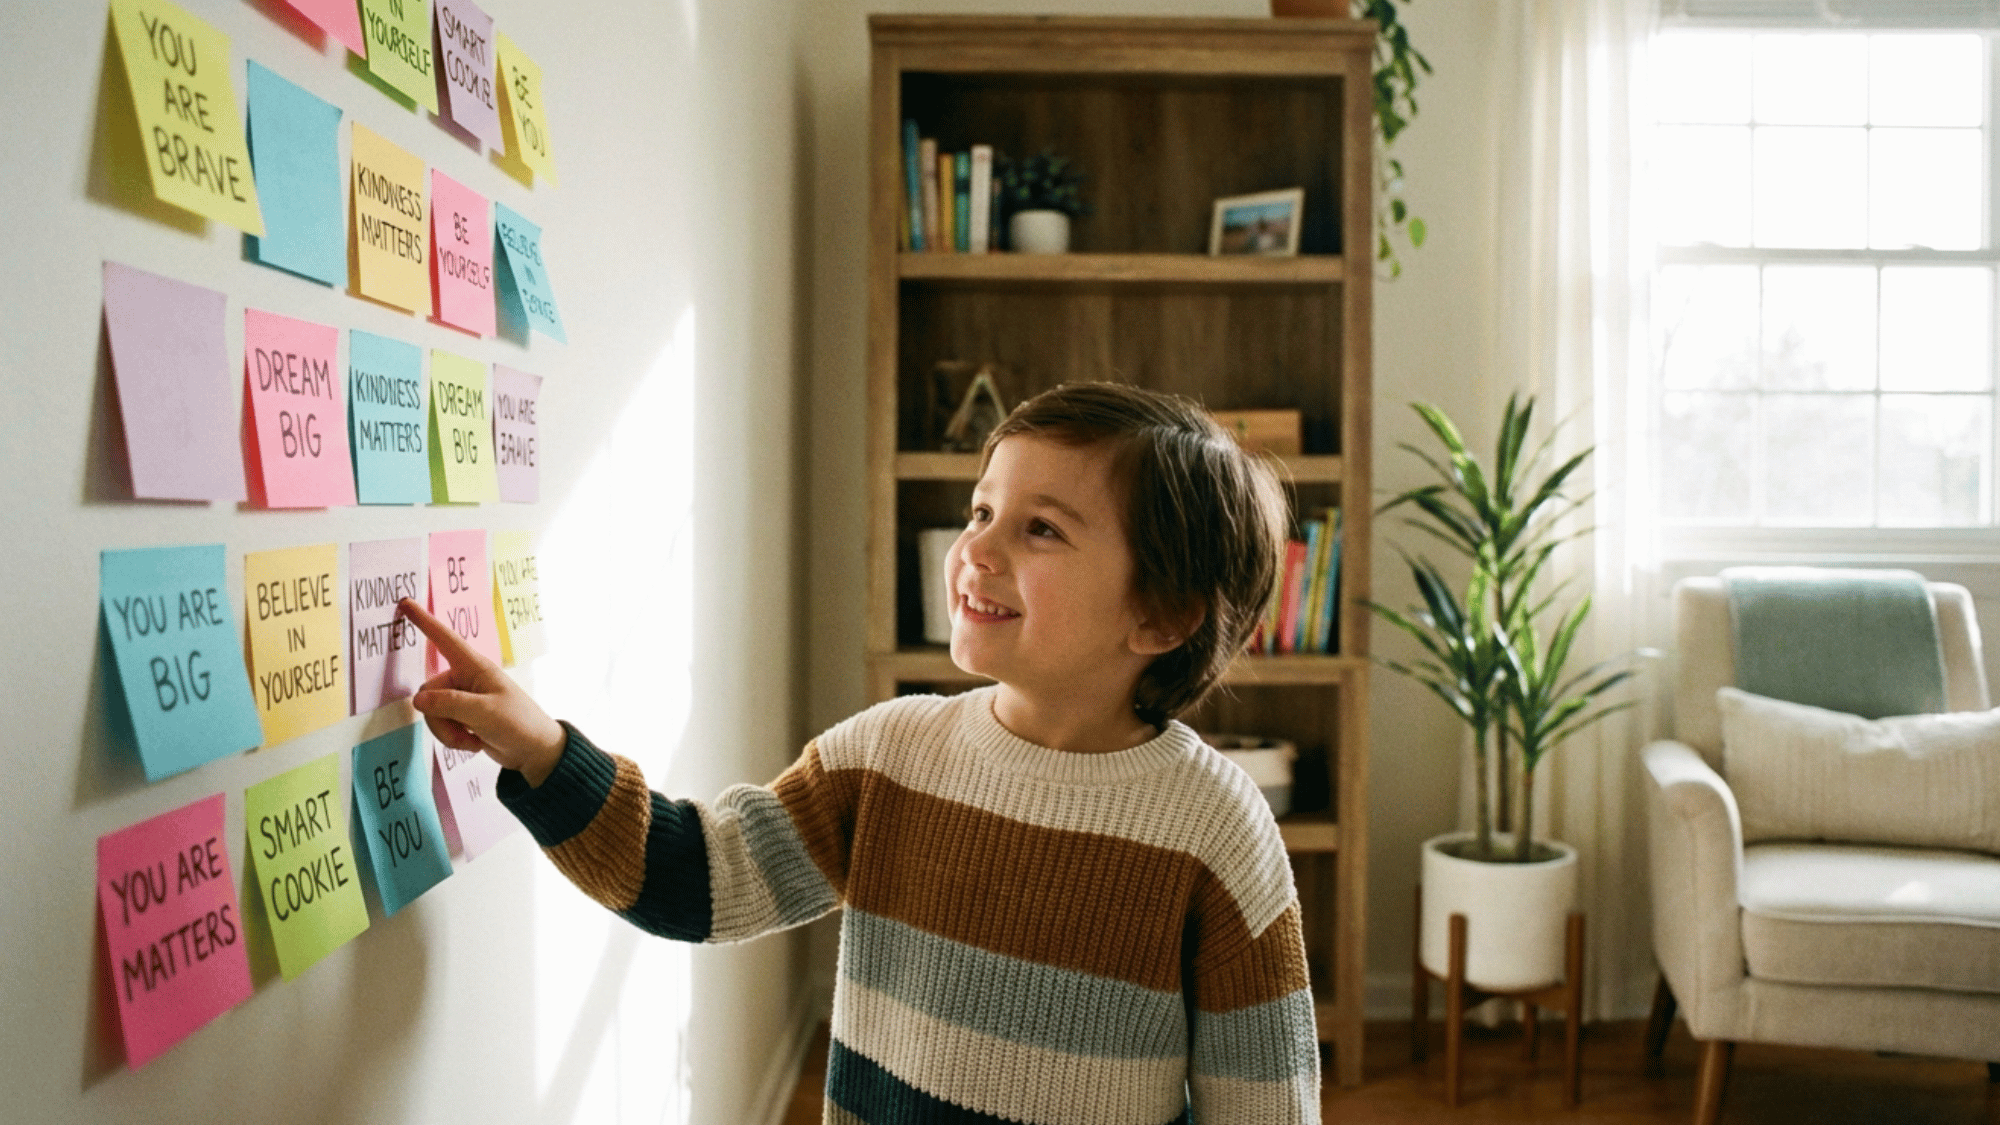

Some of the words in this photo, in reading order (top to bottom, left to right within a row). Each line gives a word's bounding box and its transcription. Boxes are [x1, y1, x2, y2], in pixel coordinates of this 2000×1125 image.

[140, 10, 197, 77] YOU
[366, 7, 431, 76] YOURSELF
[165, 78, 214, 133] ARE
[153, 125, 246, 203] BRAVE
[357, 162, 423, 222] KINDNESS
[361, 212, 423, 265] MATTERS
[453, 211, 470, 245] BE
[255, 347, 333, 400] DREAM
[355, 369, 421, 410] KINDNESS
[438, 381, 485, 420] DREAM
[279, 410, 322, 458] BIG
[359, 419, 422, 453] MATTERS
[453, 428, 478, 464] BIG
[256, 573, 332, 621] BELIEVE
[355, 571, 416, 611] KINDNESS
[447, 556, 469, 594] BE
[112, 595, 167, 642] YOU
[179, 587, 224, 631] ARE
[287, 624, 306, 653] IN
[447, 605, 479, 640] YOU
[149, 650, 211, 712] BIG
[259, 654, 339, 712] YOURSELF
[374, 760, 405, 810] BE
[260, 789, 332, 860] SMART
[378, 811, 422, 868] YOU
[110, 861, 168, 927] YOU
[177, 836, 223, 896] ARE
[271, 846, 349, 922] COOKIE
[121, 903, 237, 1003] MATTERS
